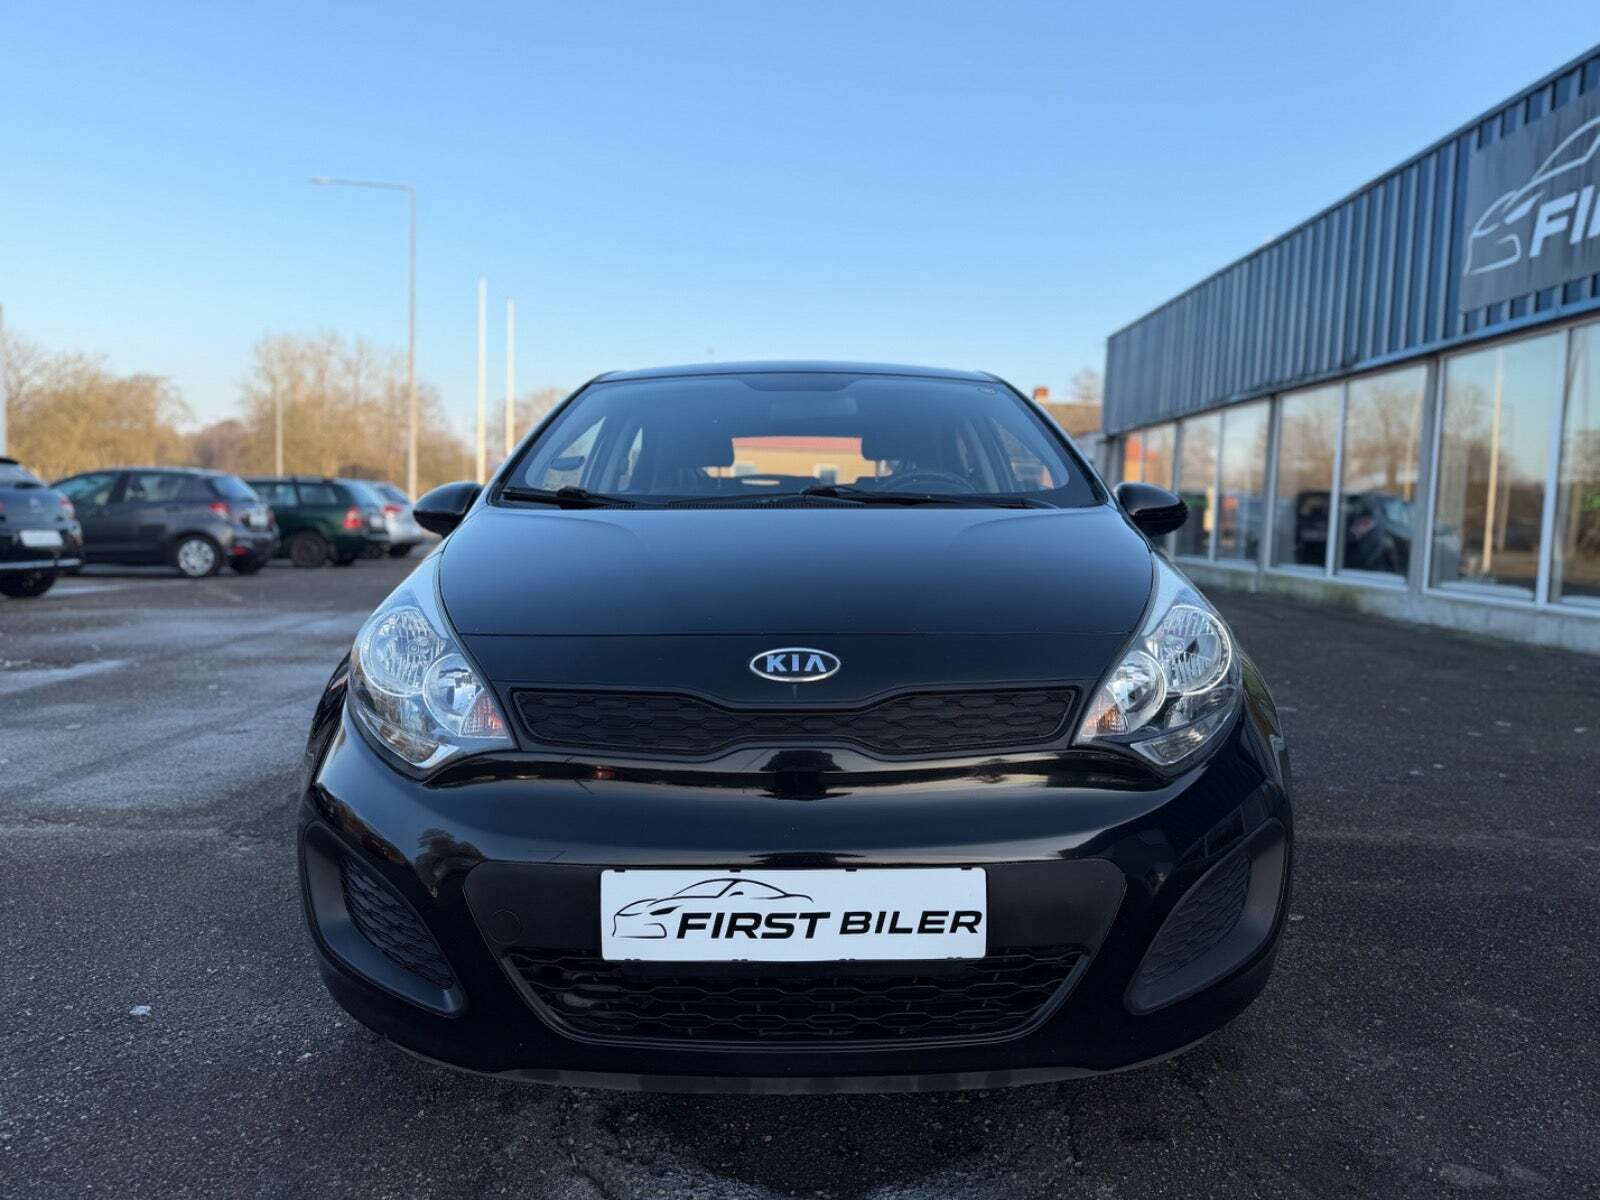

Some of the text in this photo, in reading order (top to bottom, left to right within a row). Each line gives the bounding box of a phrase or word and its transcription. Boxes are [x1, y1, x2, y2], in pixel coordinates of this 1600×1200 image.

[766, 654, 827, 673] KIA
[676, 910, 983, 939] FIRST BILER
